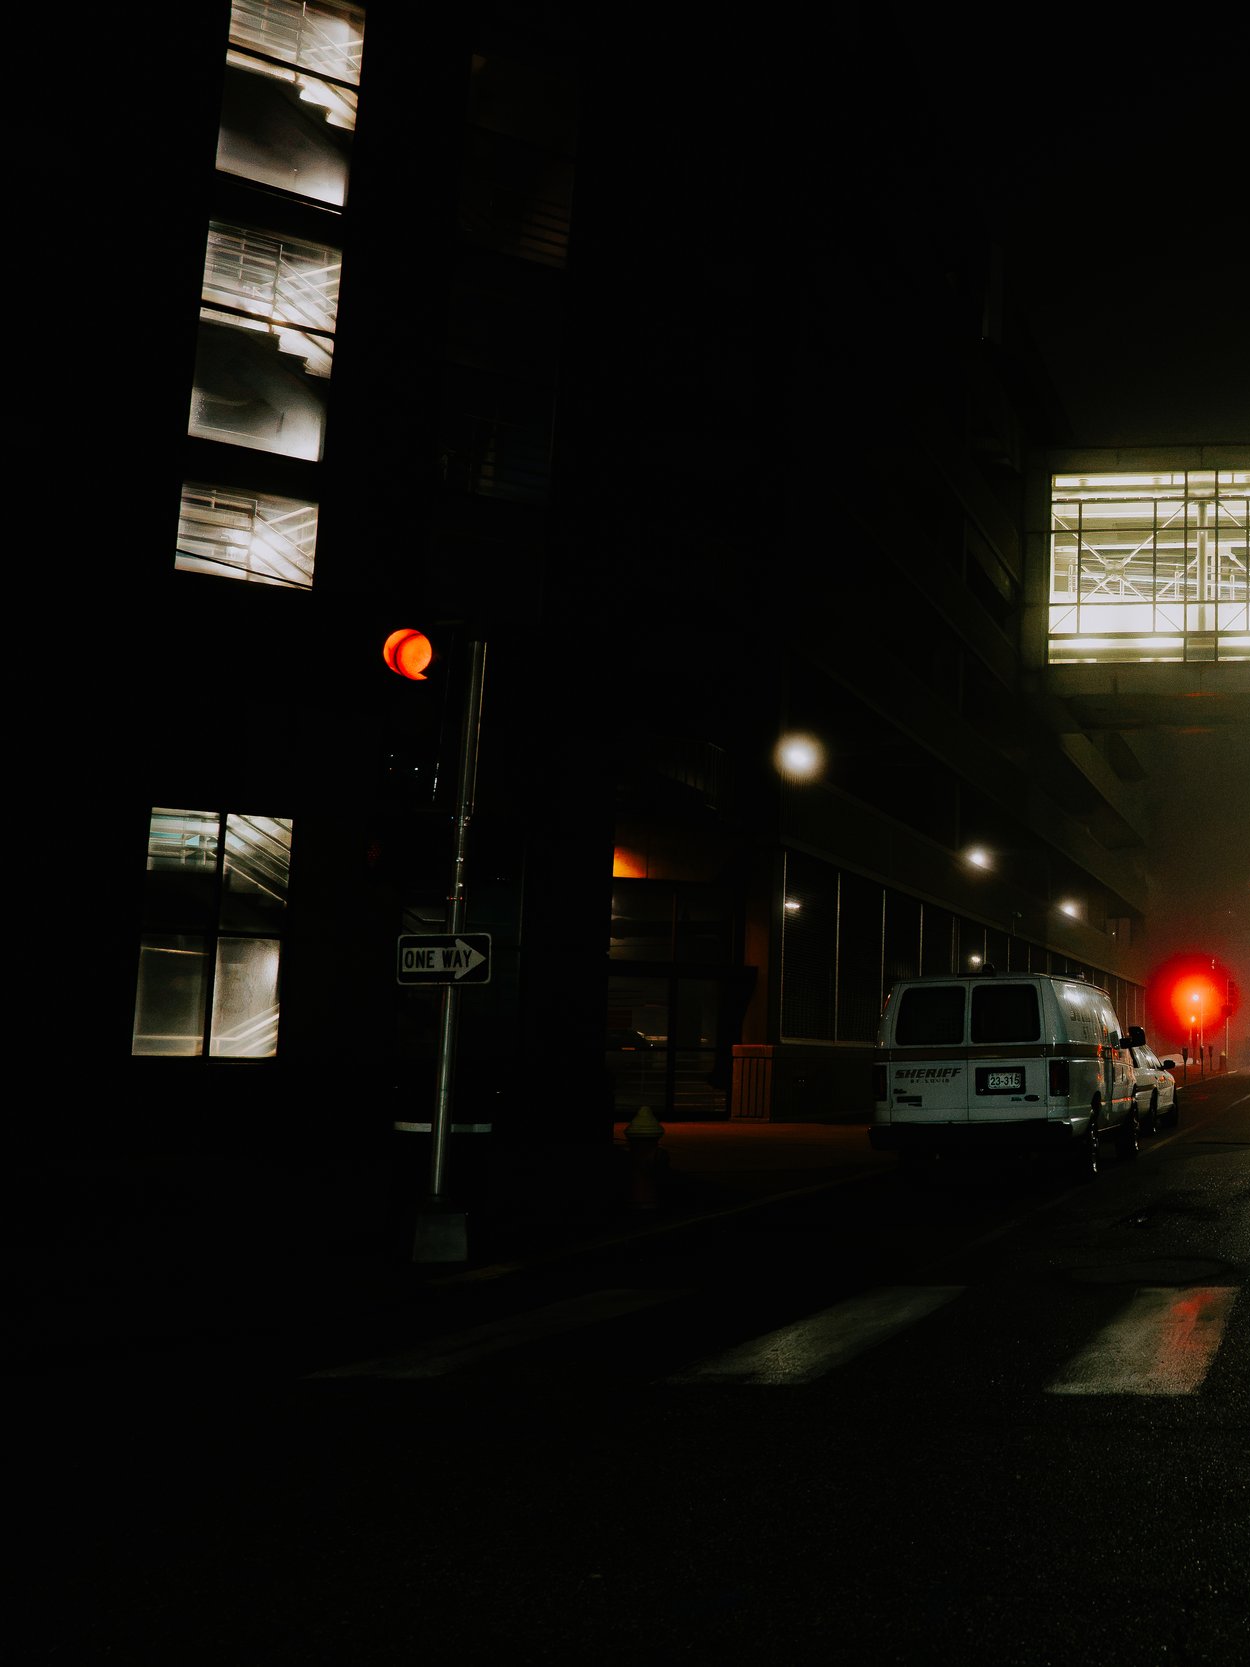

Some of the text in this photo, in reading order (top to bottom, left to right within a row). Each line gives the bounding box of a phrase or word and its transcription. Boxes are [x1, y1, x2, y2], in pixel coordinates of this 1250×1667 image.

[404, 949, 472, 969] ONE WAY
[895, 1068, 962, 1079] SHERIFF
[990, 1075, 1020, 1086] 23-315
